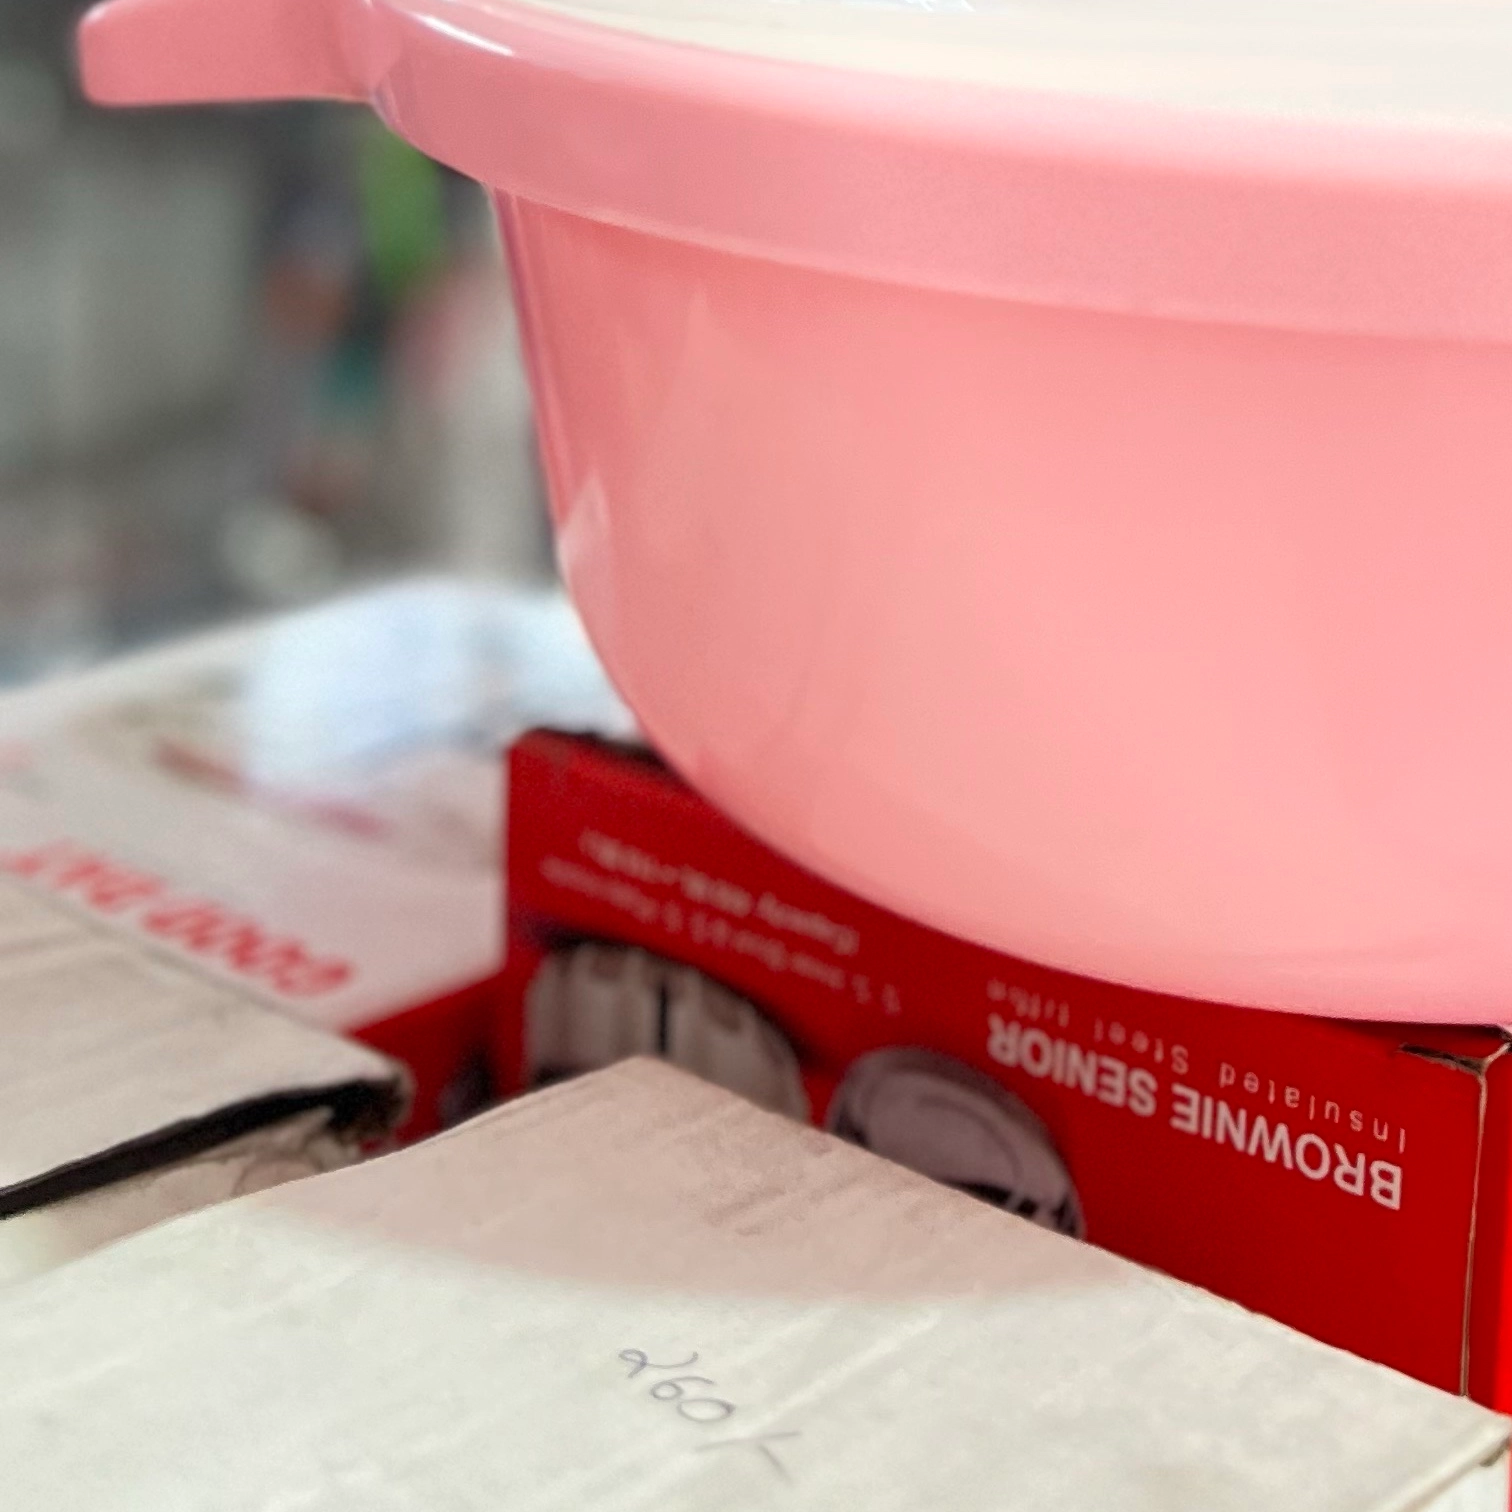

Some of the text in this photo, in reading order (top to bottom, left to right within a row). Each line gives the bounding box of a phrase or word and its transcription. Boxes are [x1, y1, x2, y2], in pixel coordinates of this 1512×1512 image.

[1094, 1017, 1189, 1075] Steel
[986, 1012, 1403, 1211] BROWNIE SENIOR
[1219, 1061, 1406, 1154] Insulated
